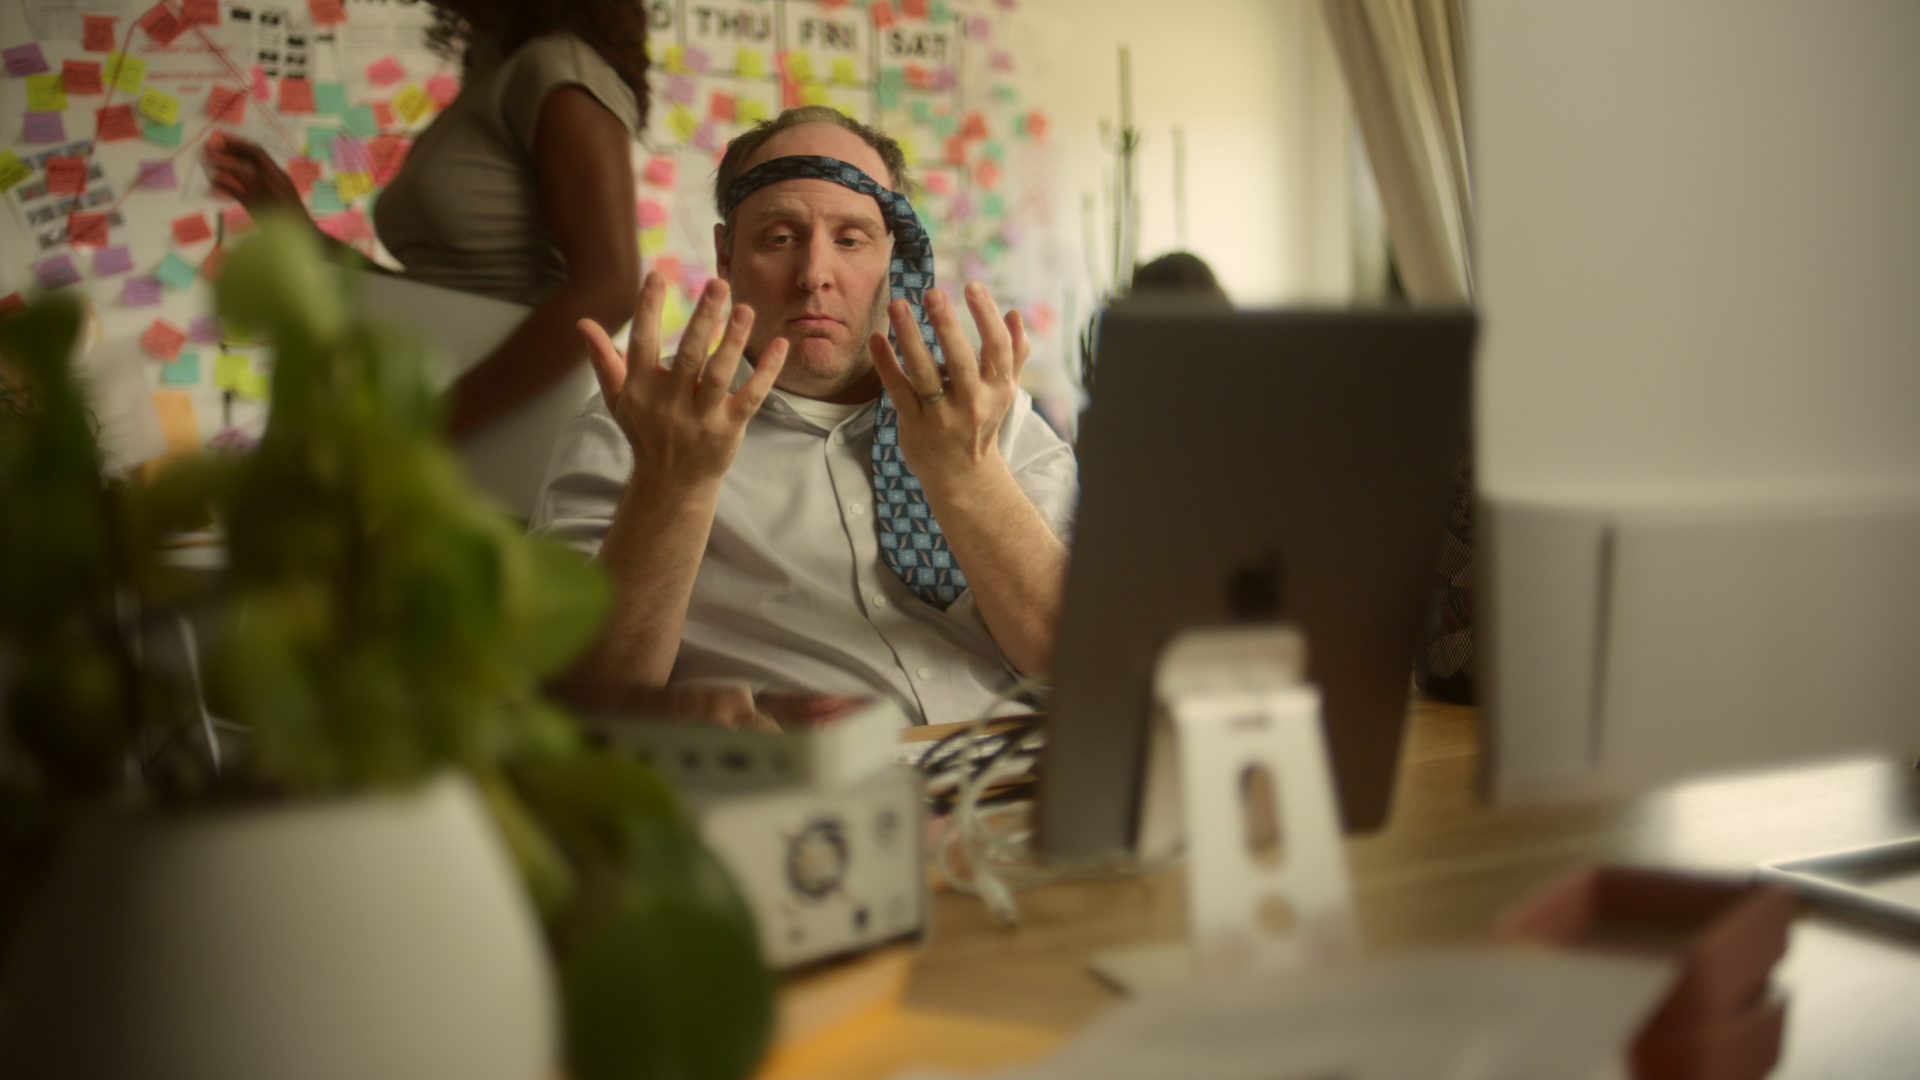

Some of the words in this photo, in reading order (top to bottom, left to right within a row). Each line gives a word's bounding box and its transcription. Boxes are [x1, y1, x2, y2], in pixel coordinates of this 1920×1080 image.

[694, 7, 770, 41] THU
[800, 19, 855, 50] FRI
[887, 30, 949, 58] SAT
